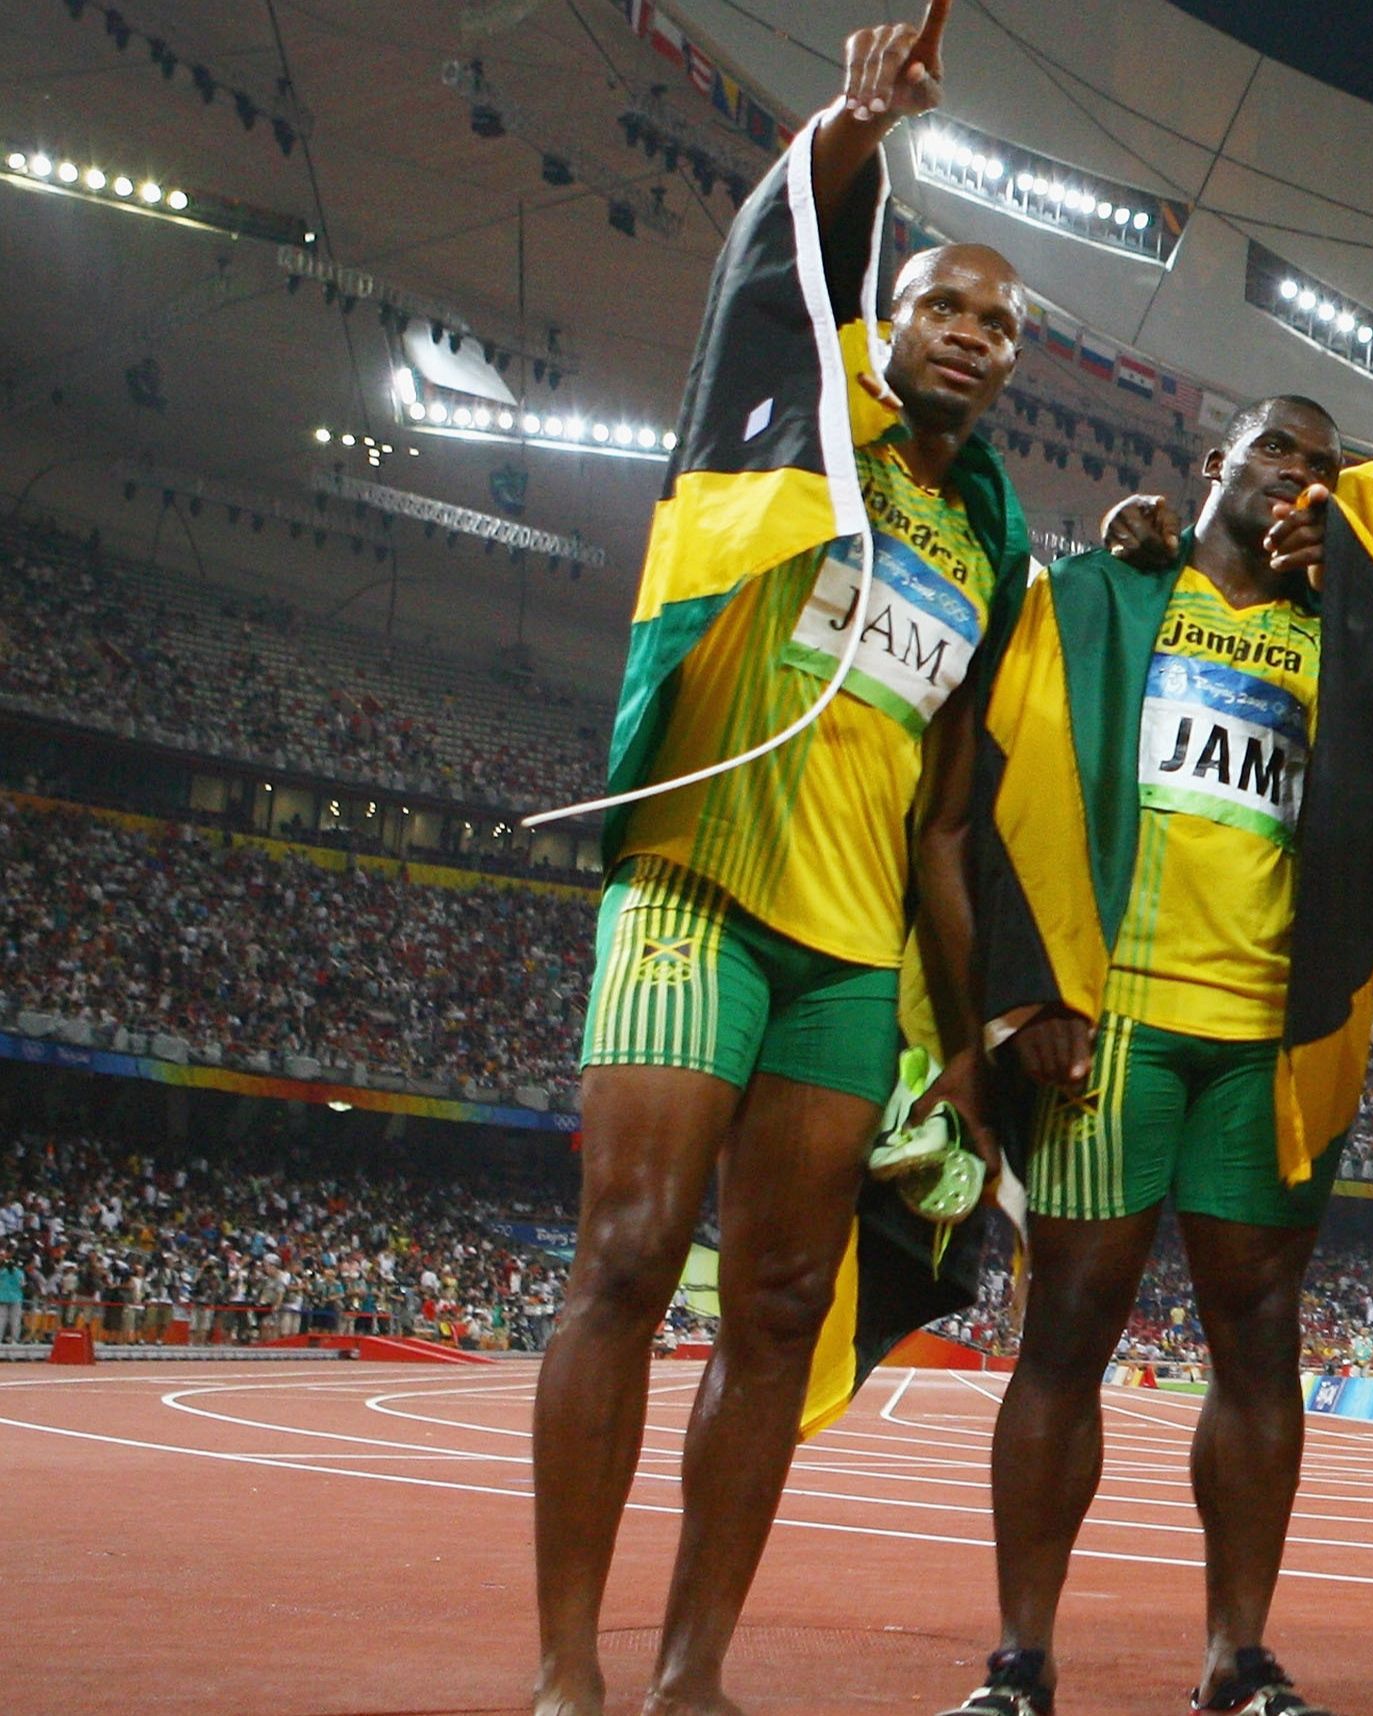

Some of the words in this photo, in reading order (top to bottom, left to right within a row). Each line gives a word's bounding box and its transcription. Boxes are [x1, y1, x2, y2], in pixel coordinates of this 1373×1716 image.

[829, 585, 951, 686] JAM
[1162, 614, 1304, 674] jamaica
[1158, 717, 1286, 807] JAM
